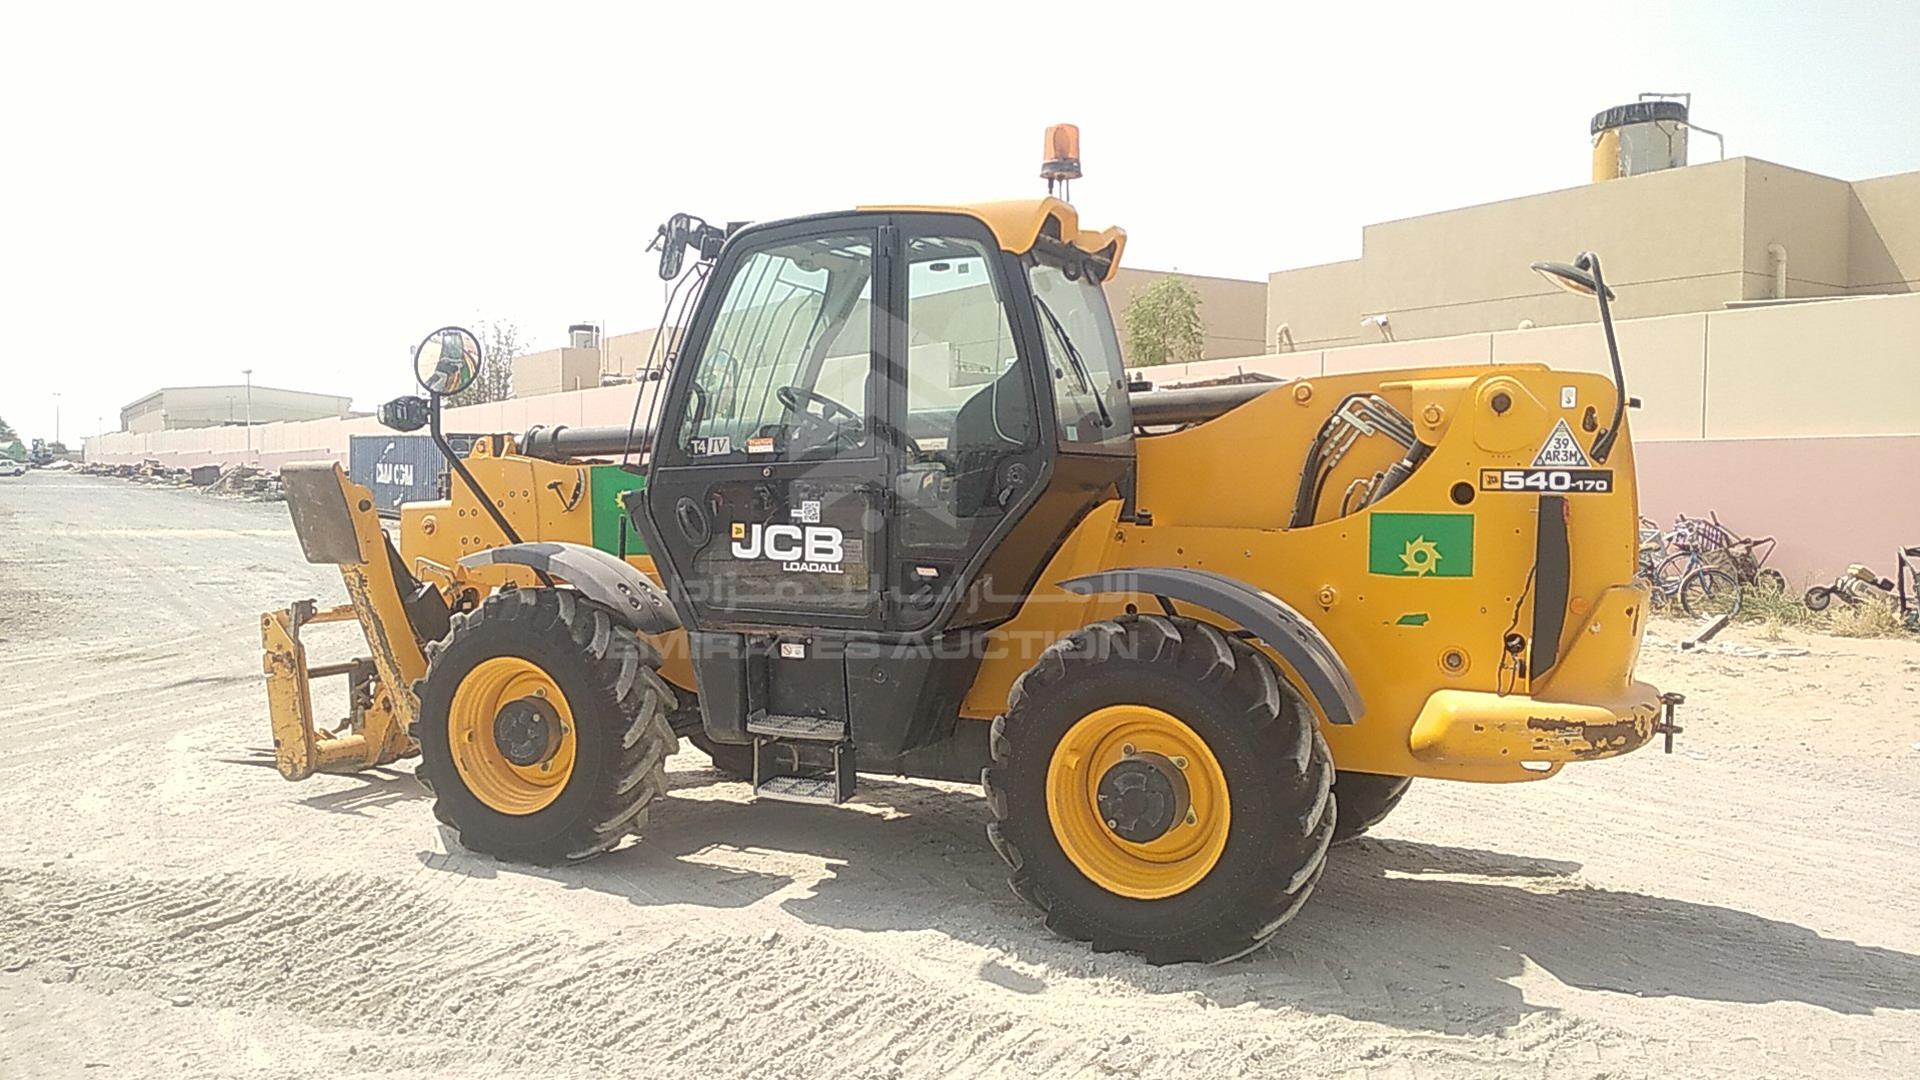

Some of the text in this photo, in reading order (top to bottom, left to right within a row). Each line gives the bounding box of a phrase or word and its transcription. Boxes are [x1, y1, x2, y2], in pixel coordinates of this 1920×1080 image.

[1553, 438, 1569, 449] 39
[1545, 450, 1578, 462] AR3M
[732, 523, 843, 561] JCB
[783, 562, 843, 573] LOADALL
